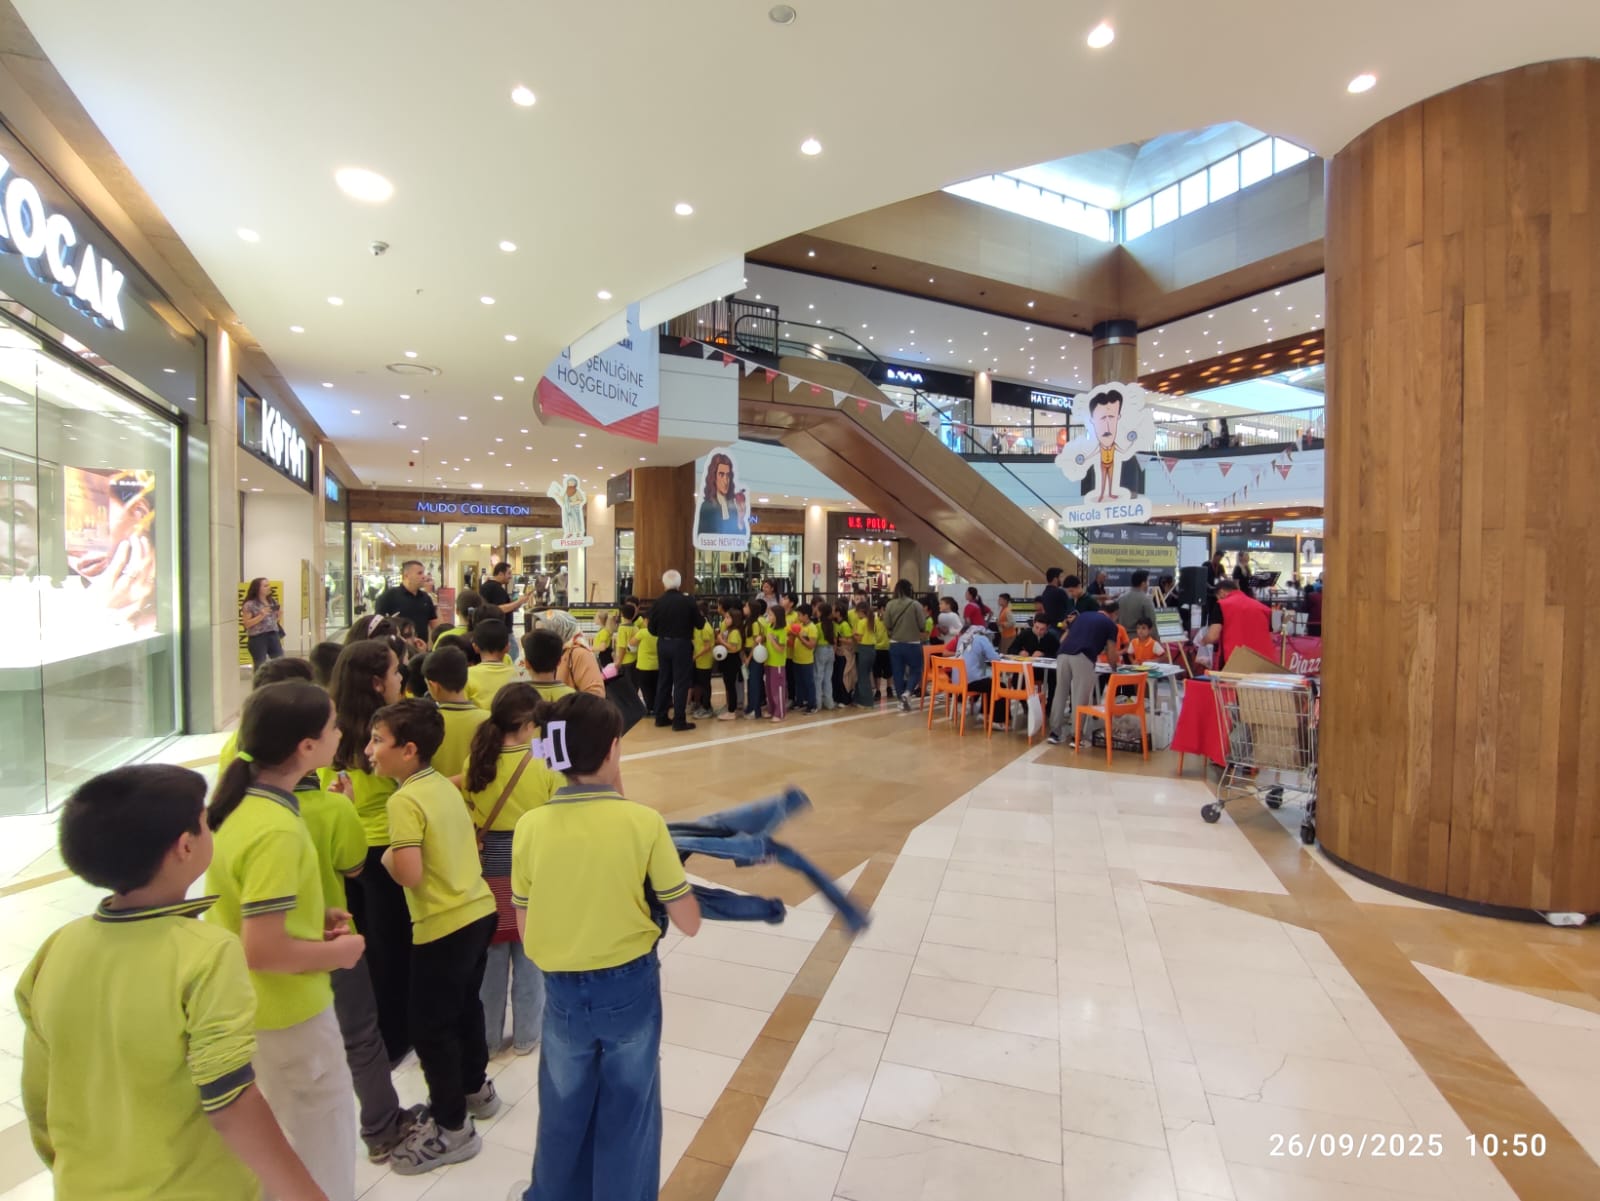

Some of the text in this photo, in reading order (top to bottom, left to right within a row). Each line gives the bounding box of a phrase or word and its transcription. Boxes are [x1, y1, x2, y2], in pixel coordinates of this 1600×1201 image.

[557, 364, 638, 407] HOŞGELDİNİZ
[417, 502, 530, 515] MUDO COLLECTION
[1069, 504, 1144, 522] Nicola TESLA
[866, 517, 886, 529] POLO
[701, 537, 717, 546] Isaac
[1289, 652, 1321, 675] Piazz
